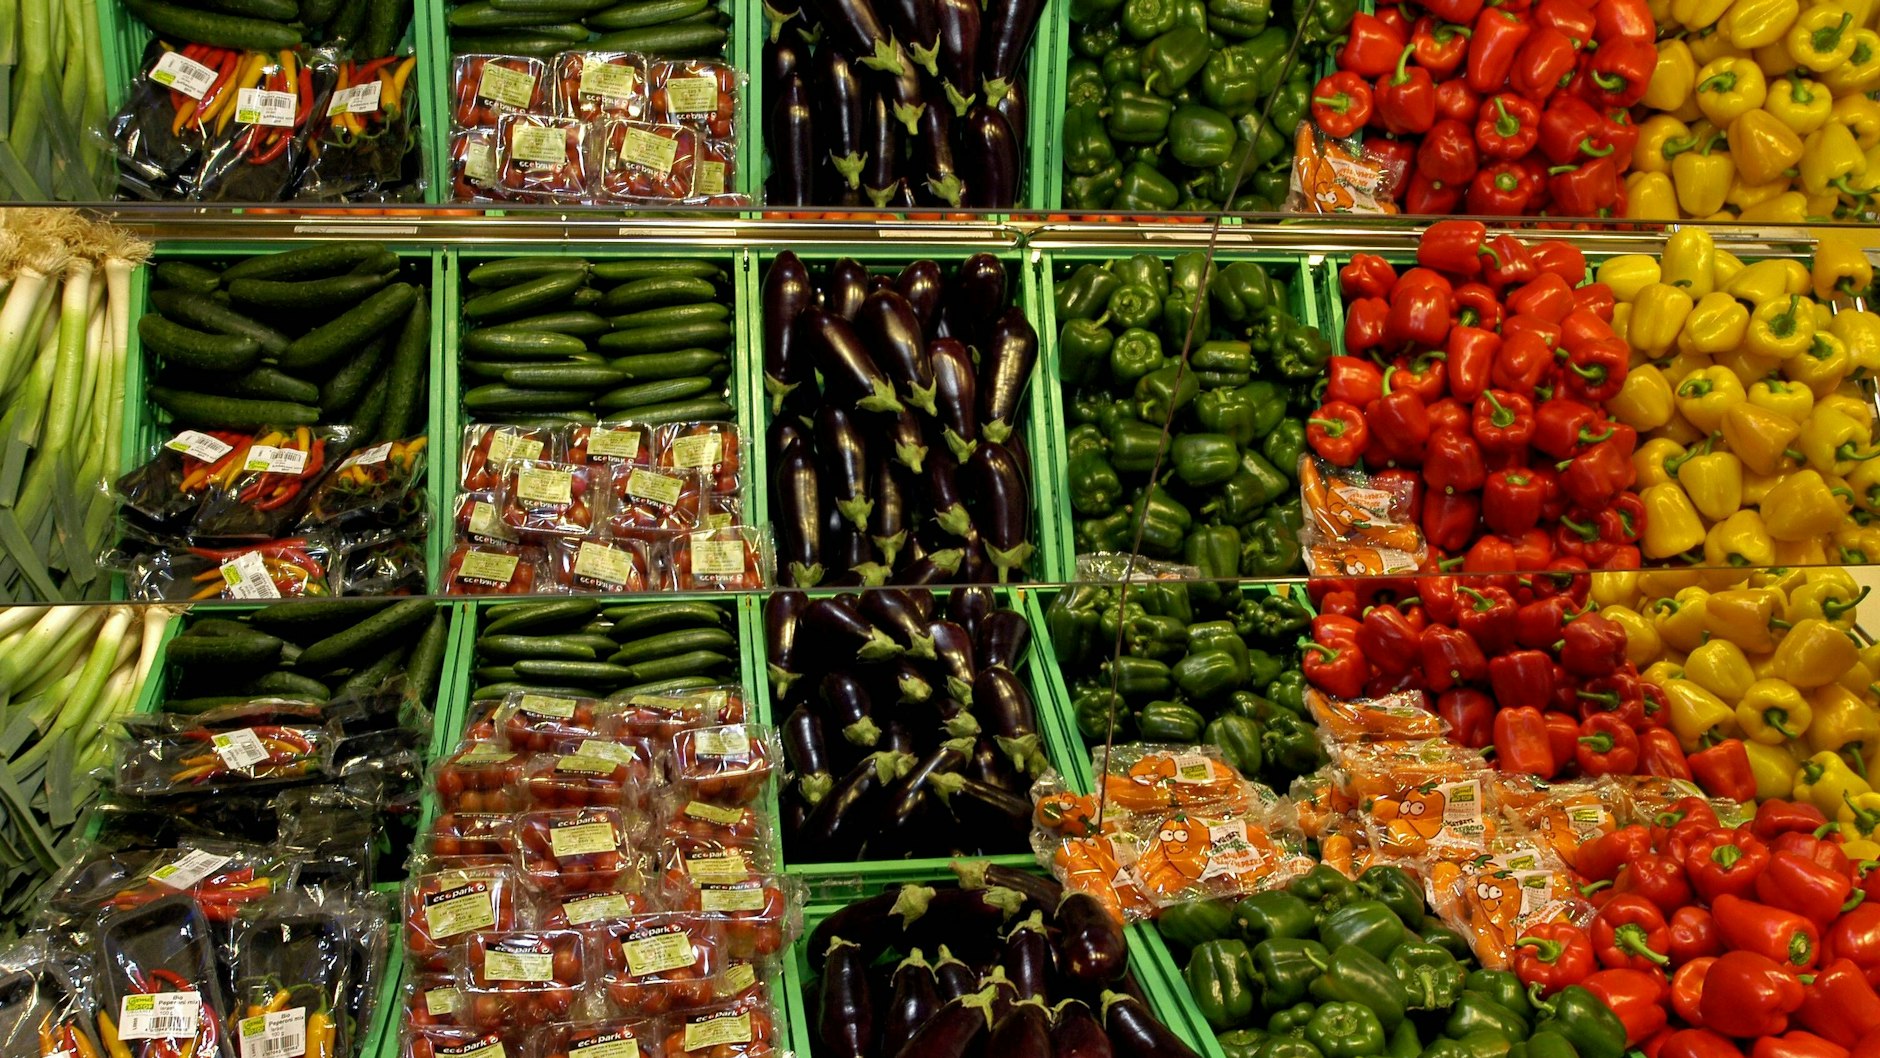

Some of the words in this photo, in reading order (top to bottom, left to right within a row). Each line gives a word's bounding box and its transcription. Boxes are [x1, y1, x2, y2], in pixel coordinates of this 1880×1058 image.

[558, 816, 597, 827] ecopark
[691, 851, 728, 859] ecopark
[433, 886, 474, 903] ecopark
[629, 926, 670, 940] ecopark
[495, 945, 538, 954] ecopark
[695, 1010, 738, 1023] ecopark
[443, 1039, 487, 1053] ecopark
[578, 1032, 621, 1048] ecopark
